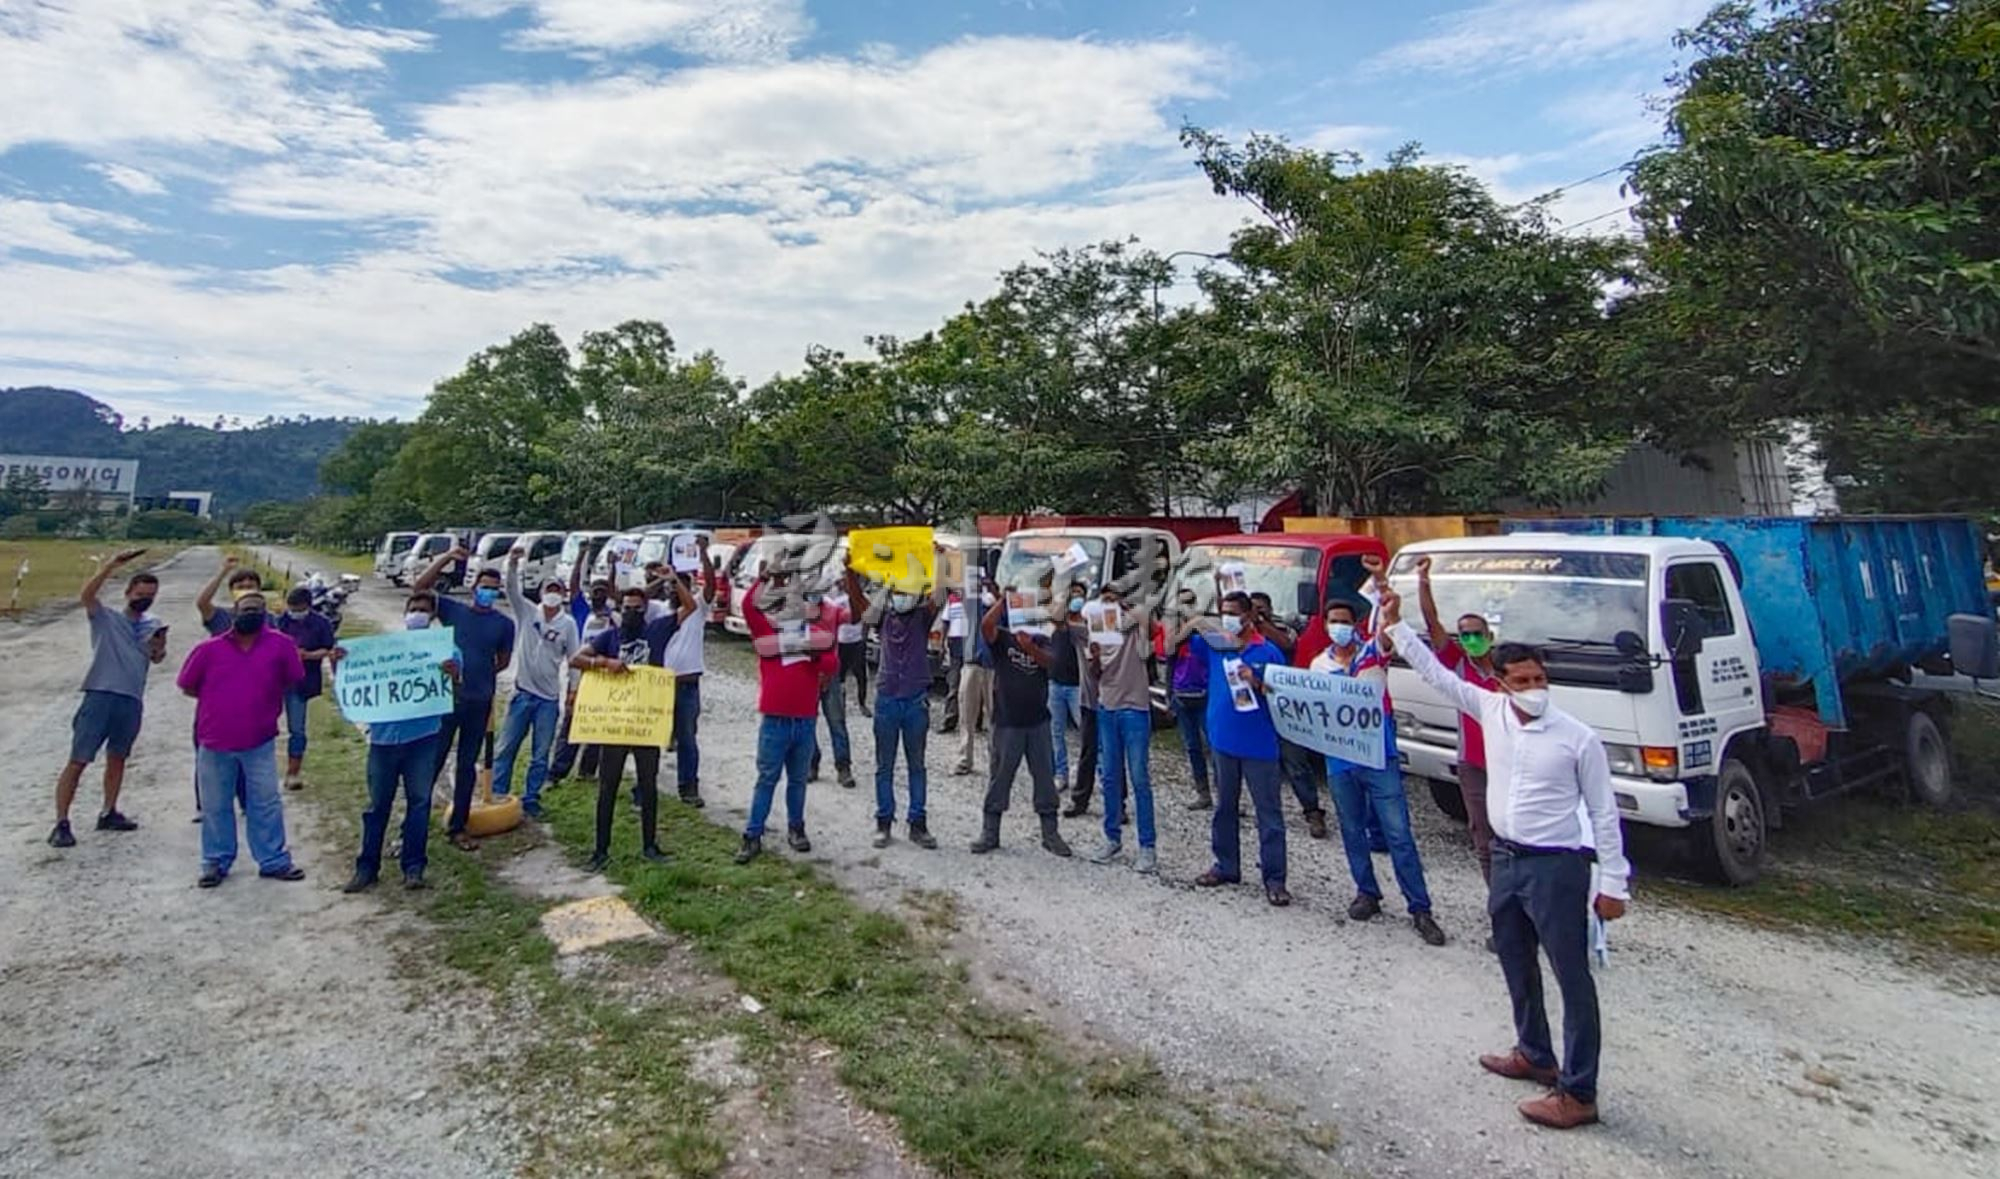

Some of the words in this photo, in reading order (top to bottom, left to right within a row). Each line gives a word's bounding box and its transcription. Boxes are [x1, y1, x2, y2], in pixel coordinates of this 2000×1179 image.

[342, 684, 380, 707] LORI
[388, 676, 453, 703] ROSAK
[1340, 682, 1375, 698] HARGA
